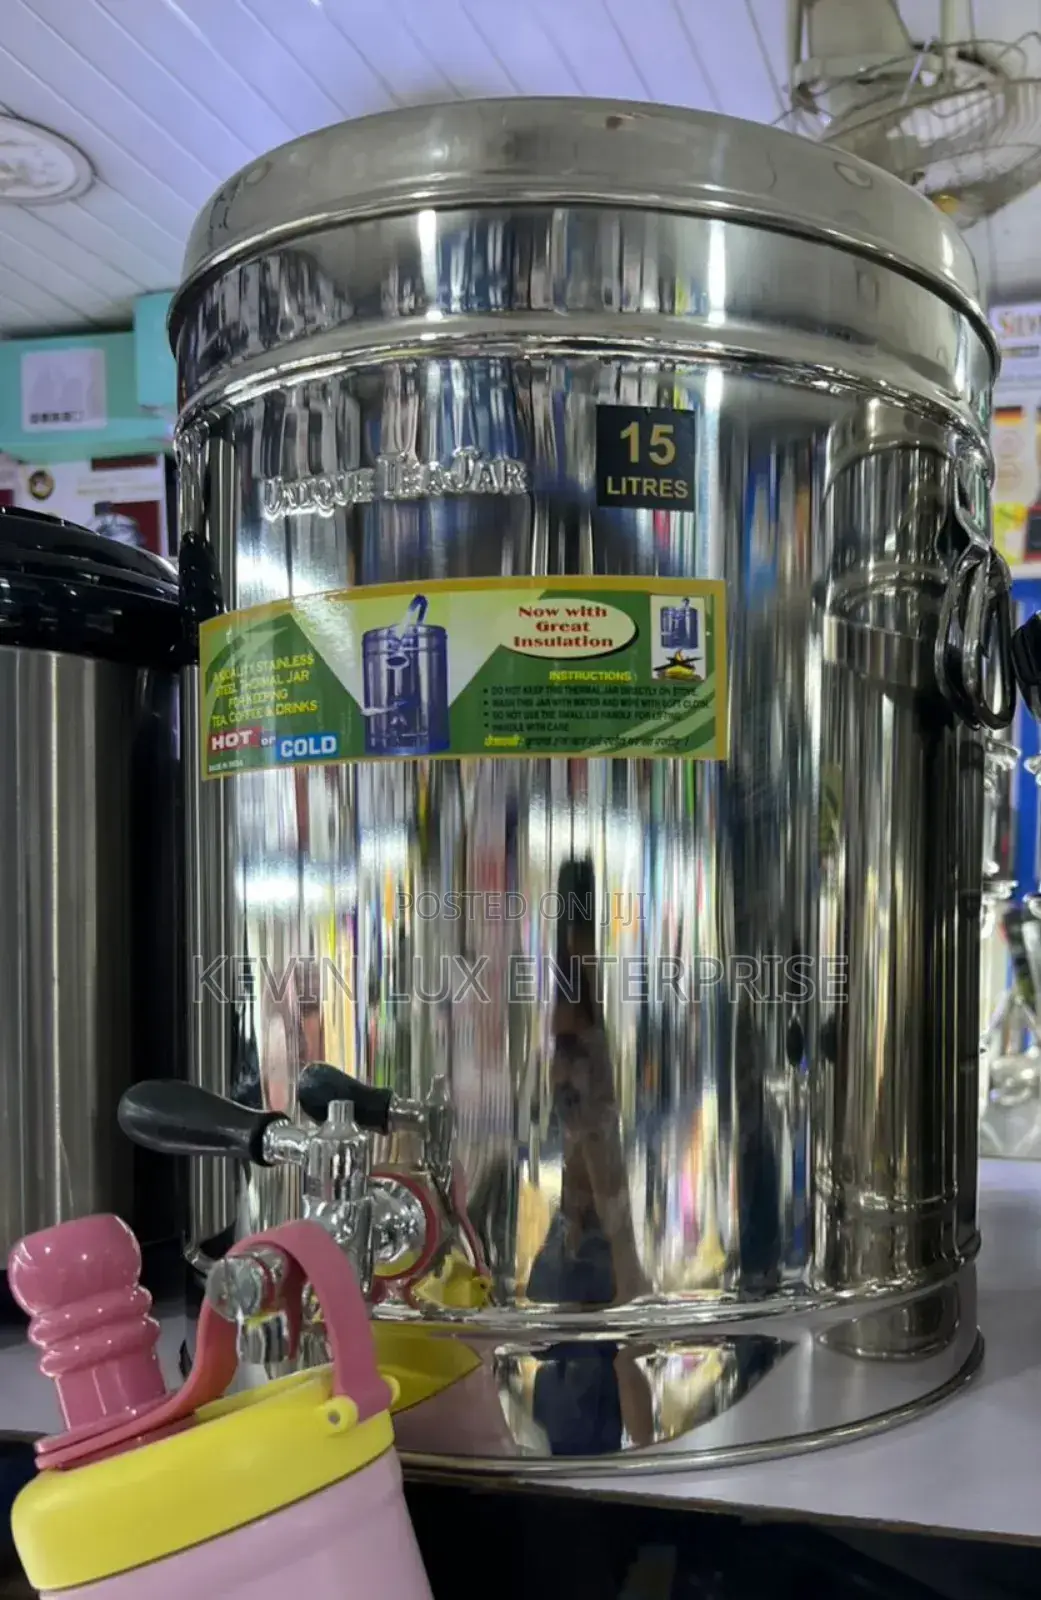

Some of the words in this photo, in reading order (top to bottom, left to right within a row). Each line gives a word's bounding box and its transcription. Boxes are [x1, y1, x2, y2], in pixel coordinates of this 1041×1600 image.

[620, 421, 676, 466] 15
[607, 476, 689, 499] LITRES
[518, 606, 559, 618] Now
[565, 605, 607, 618] with
[535, 620, 591, 632] Great
[513, 635, 613, 648] Insulation
[256, 653, 315, 673] STAINLESS
[287, 670, 310, 684] JAR
[549, 670, 632, 682] INSTRUCTIONS
[212, 714, 228, 728] TEA
[229, 707, 264, 723] COFFEE
[275, 699, 318, 716] DRINKS
[211, 730, 254, 751] HOT
[261, 736, 276, 746] or
[281, 735, 337, 758] COLD
